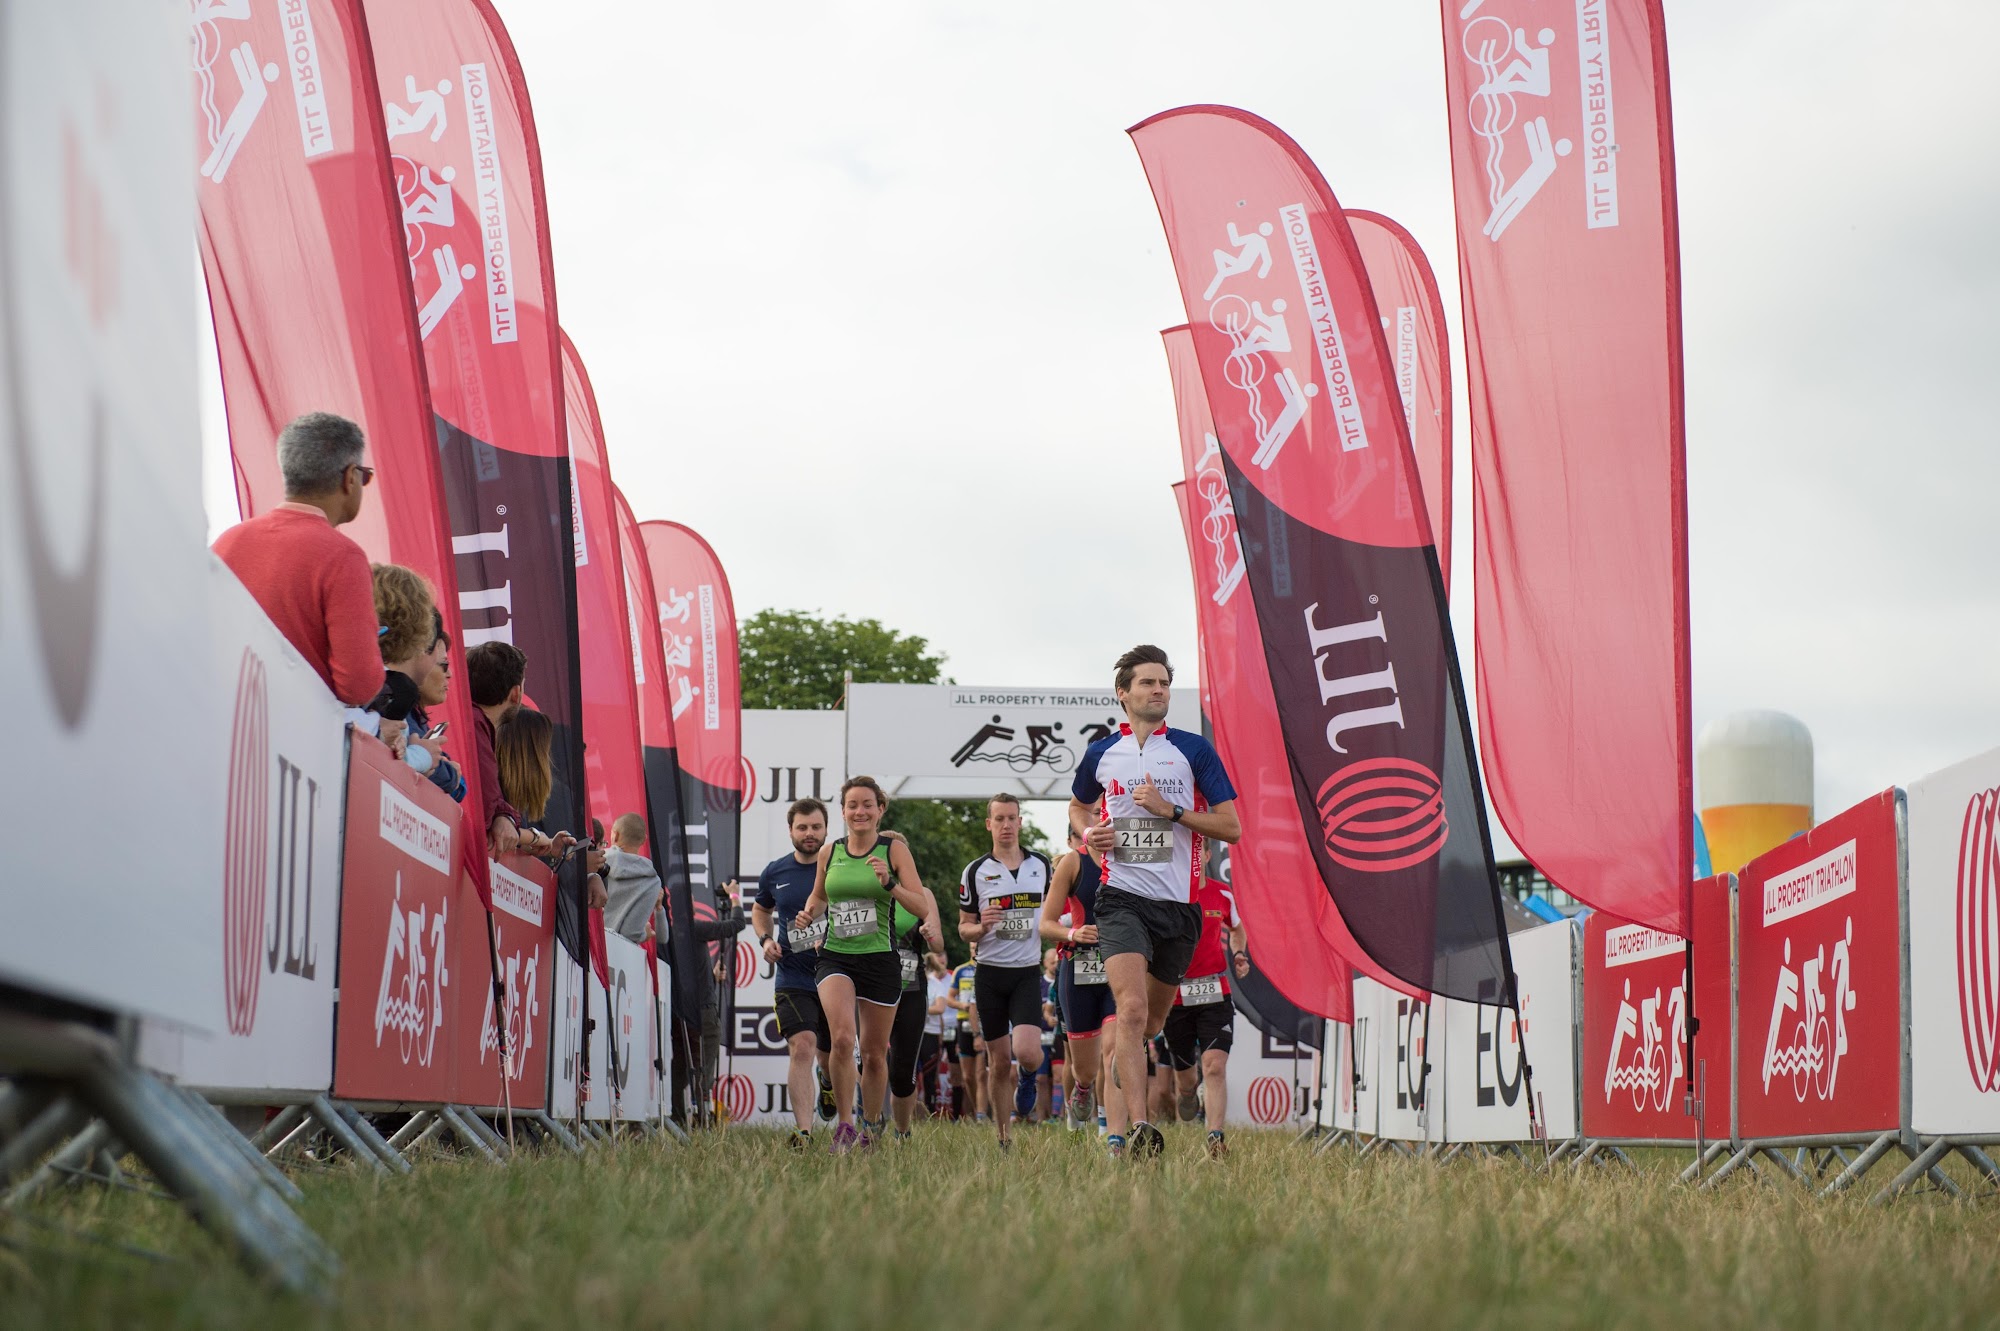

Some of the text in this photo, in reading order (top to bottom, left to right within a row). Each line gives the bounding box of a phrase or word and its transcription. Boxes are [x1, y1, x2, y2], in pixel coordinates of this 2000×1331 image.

[955, 694, 1119, 707] JLL PROPERTY TRIATHLON
[760, 766, 834, 803] JLL
[1127, 778, 1176, 786] CUSMAN
[393, 802, 420, 847] PROPERTY
[420, 821, 449, 863] TRIATHLON
[1140, 820, 1155, 829] JLL
[1121, 832, 1165, 847] 2144
[266, 753, 318, 981] JLL
[1765, 852, 1854, 915] JLL PROPERTY TRIATHLON
[496, 873, 518, 905] PROPERTY
[517, 886, 542, 916] TRIATHLON
[837, 909, 869, 925] 2417
[1002, 920, 1030, 930] 2081
[793, 922, 822, 941] 2531
[1607, 937, 1617, 958] JLL
[1619, 929, 1652, 956] PROPERTY
[1082, 961, 1106, 973] 242
[1187, 983, 1216, 995] 2328
[758, 1083, 802, 1113] JL
